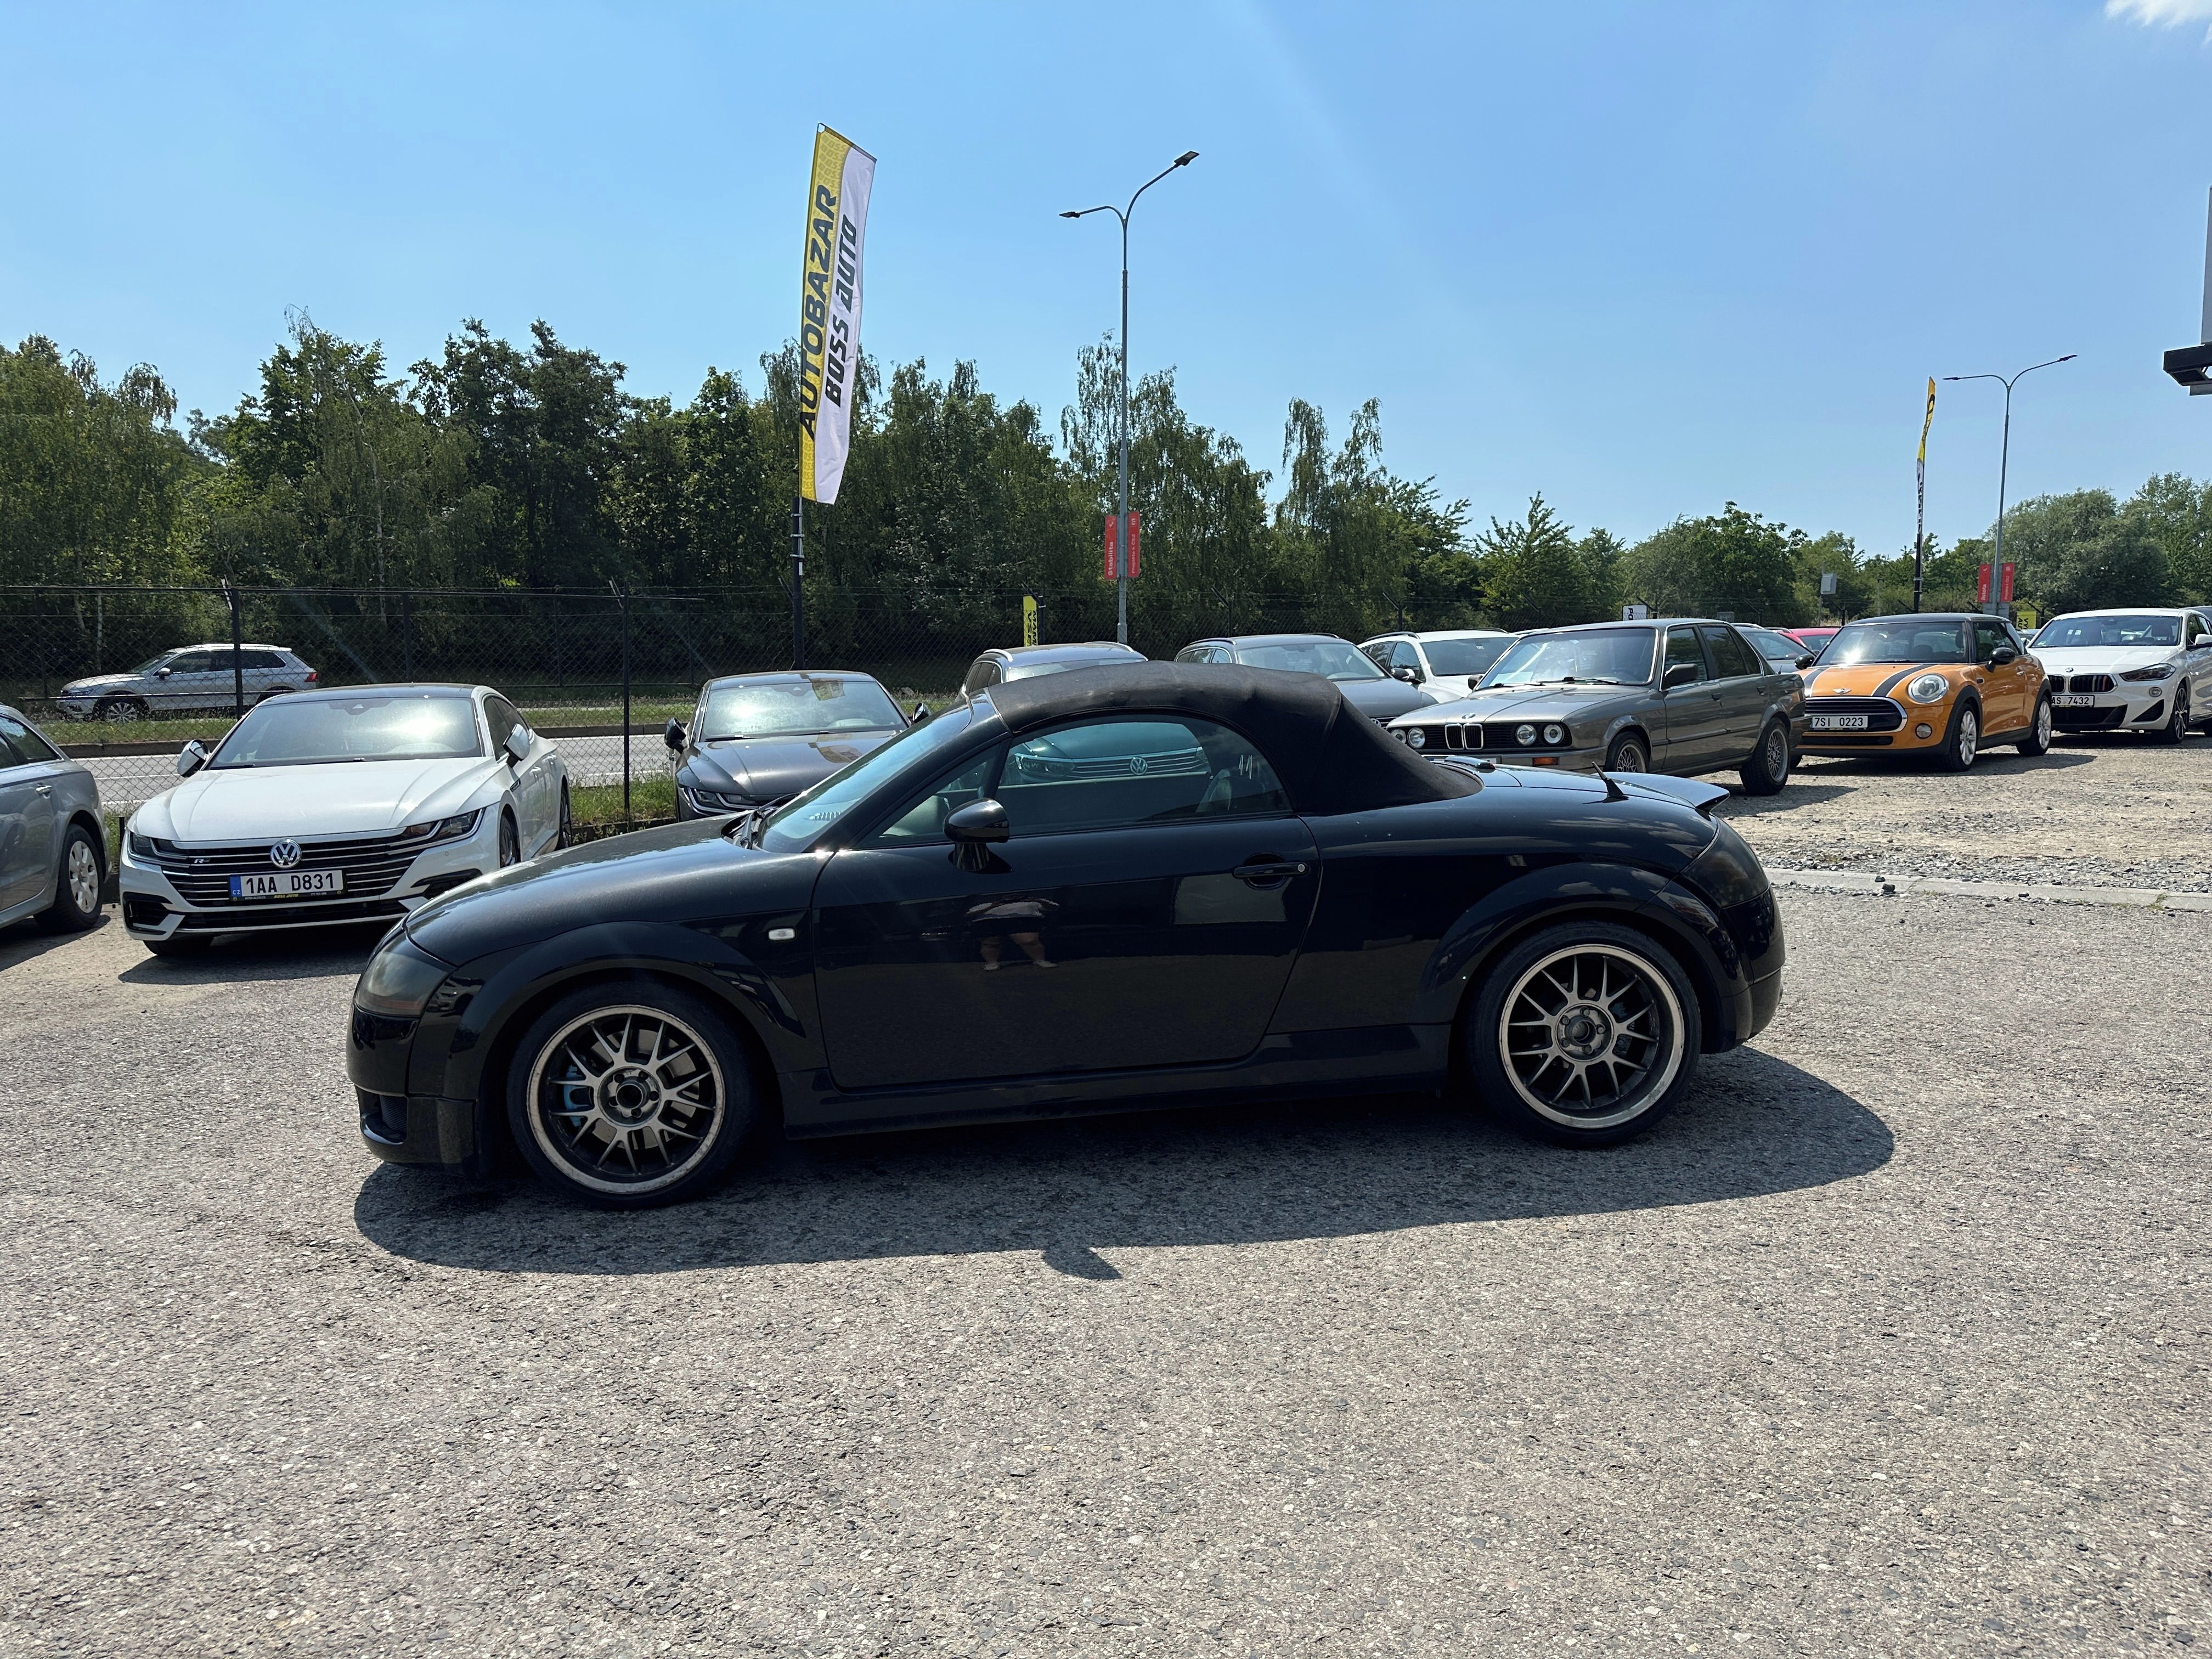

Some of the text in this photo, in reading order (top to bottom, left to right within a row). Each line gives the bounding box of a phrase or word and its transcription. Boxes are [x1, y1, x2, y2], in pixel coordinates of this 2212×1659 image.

[799, 184, 837, 442] AUTOBAZAR
[825, 214, 857, 408] BOSS AUTO
[2068, 697, 2090, 705] 7432
[1839, 717, 1863, 726] 0223
[246, 872, 334, 894] 1AA D831
